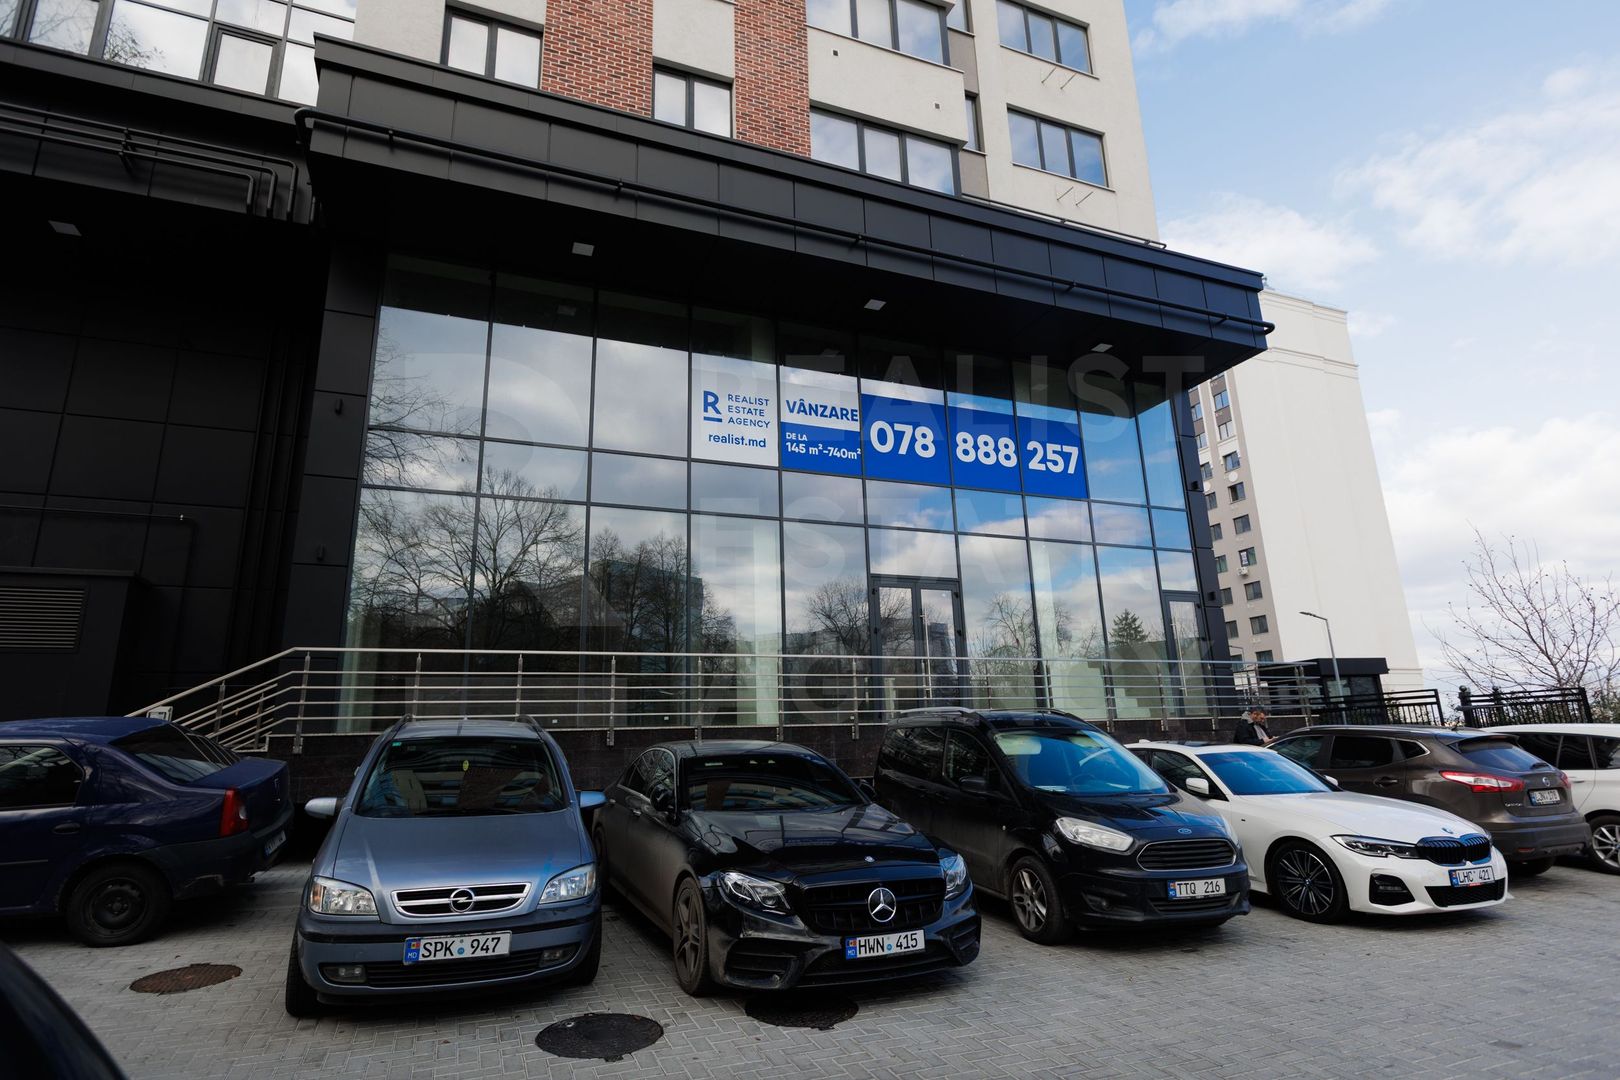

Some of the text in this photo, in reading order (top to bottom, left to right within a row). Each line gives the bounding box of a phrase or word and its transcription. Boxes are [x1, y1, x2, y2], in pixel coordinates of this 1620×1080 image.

[703, 390, 722, 414] R
[727, 393, 770, 406] REALIST
[727, 404, 765, 417] ESTATE
[786, 399, 859, 422] VÂNZARE
[727, 416, 771, 429] AGENCY
[708, 433, 767, 448] realist.md
[786, 432, 808, 441] DE LA
[786, 441, 806, 454] 145
[870, 420, 1079, 475] 078 888 257
[1177, 882, 1196, 896] TTQ
[1203, 880, 1221, 894] 216
[421, 936, 502, 958] SPK 947
[858, 932, 918, 955] HWN 415
